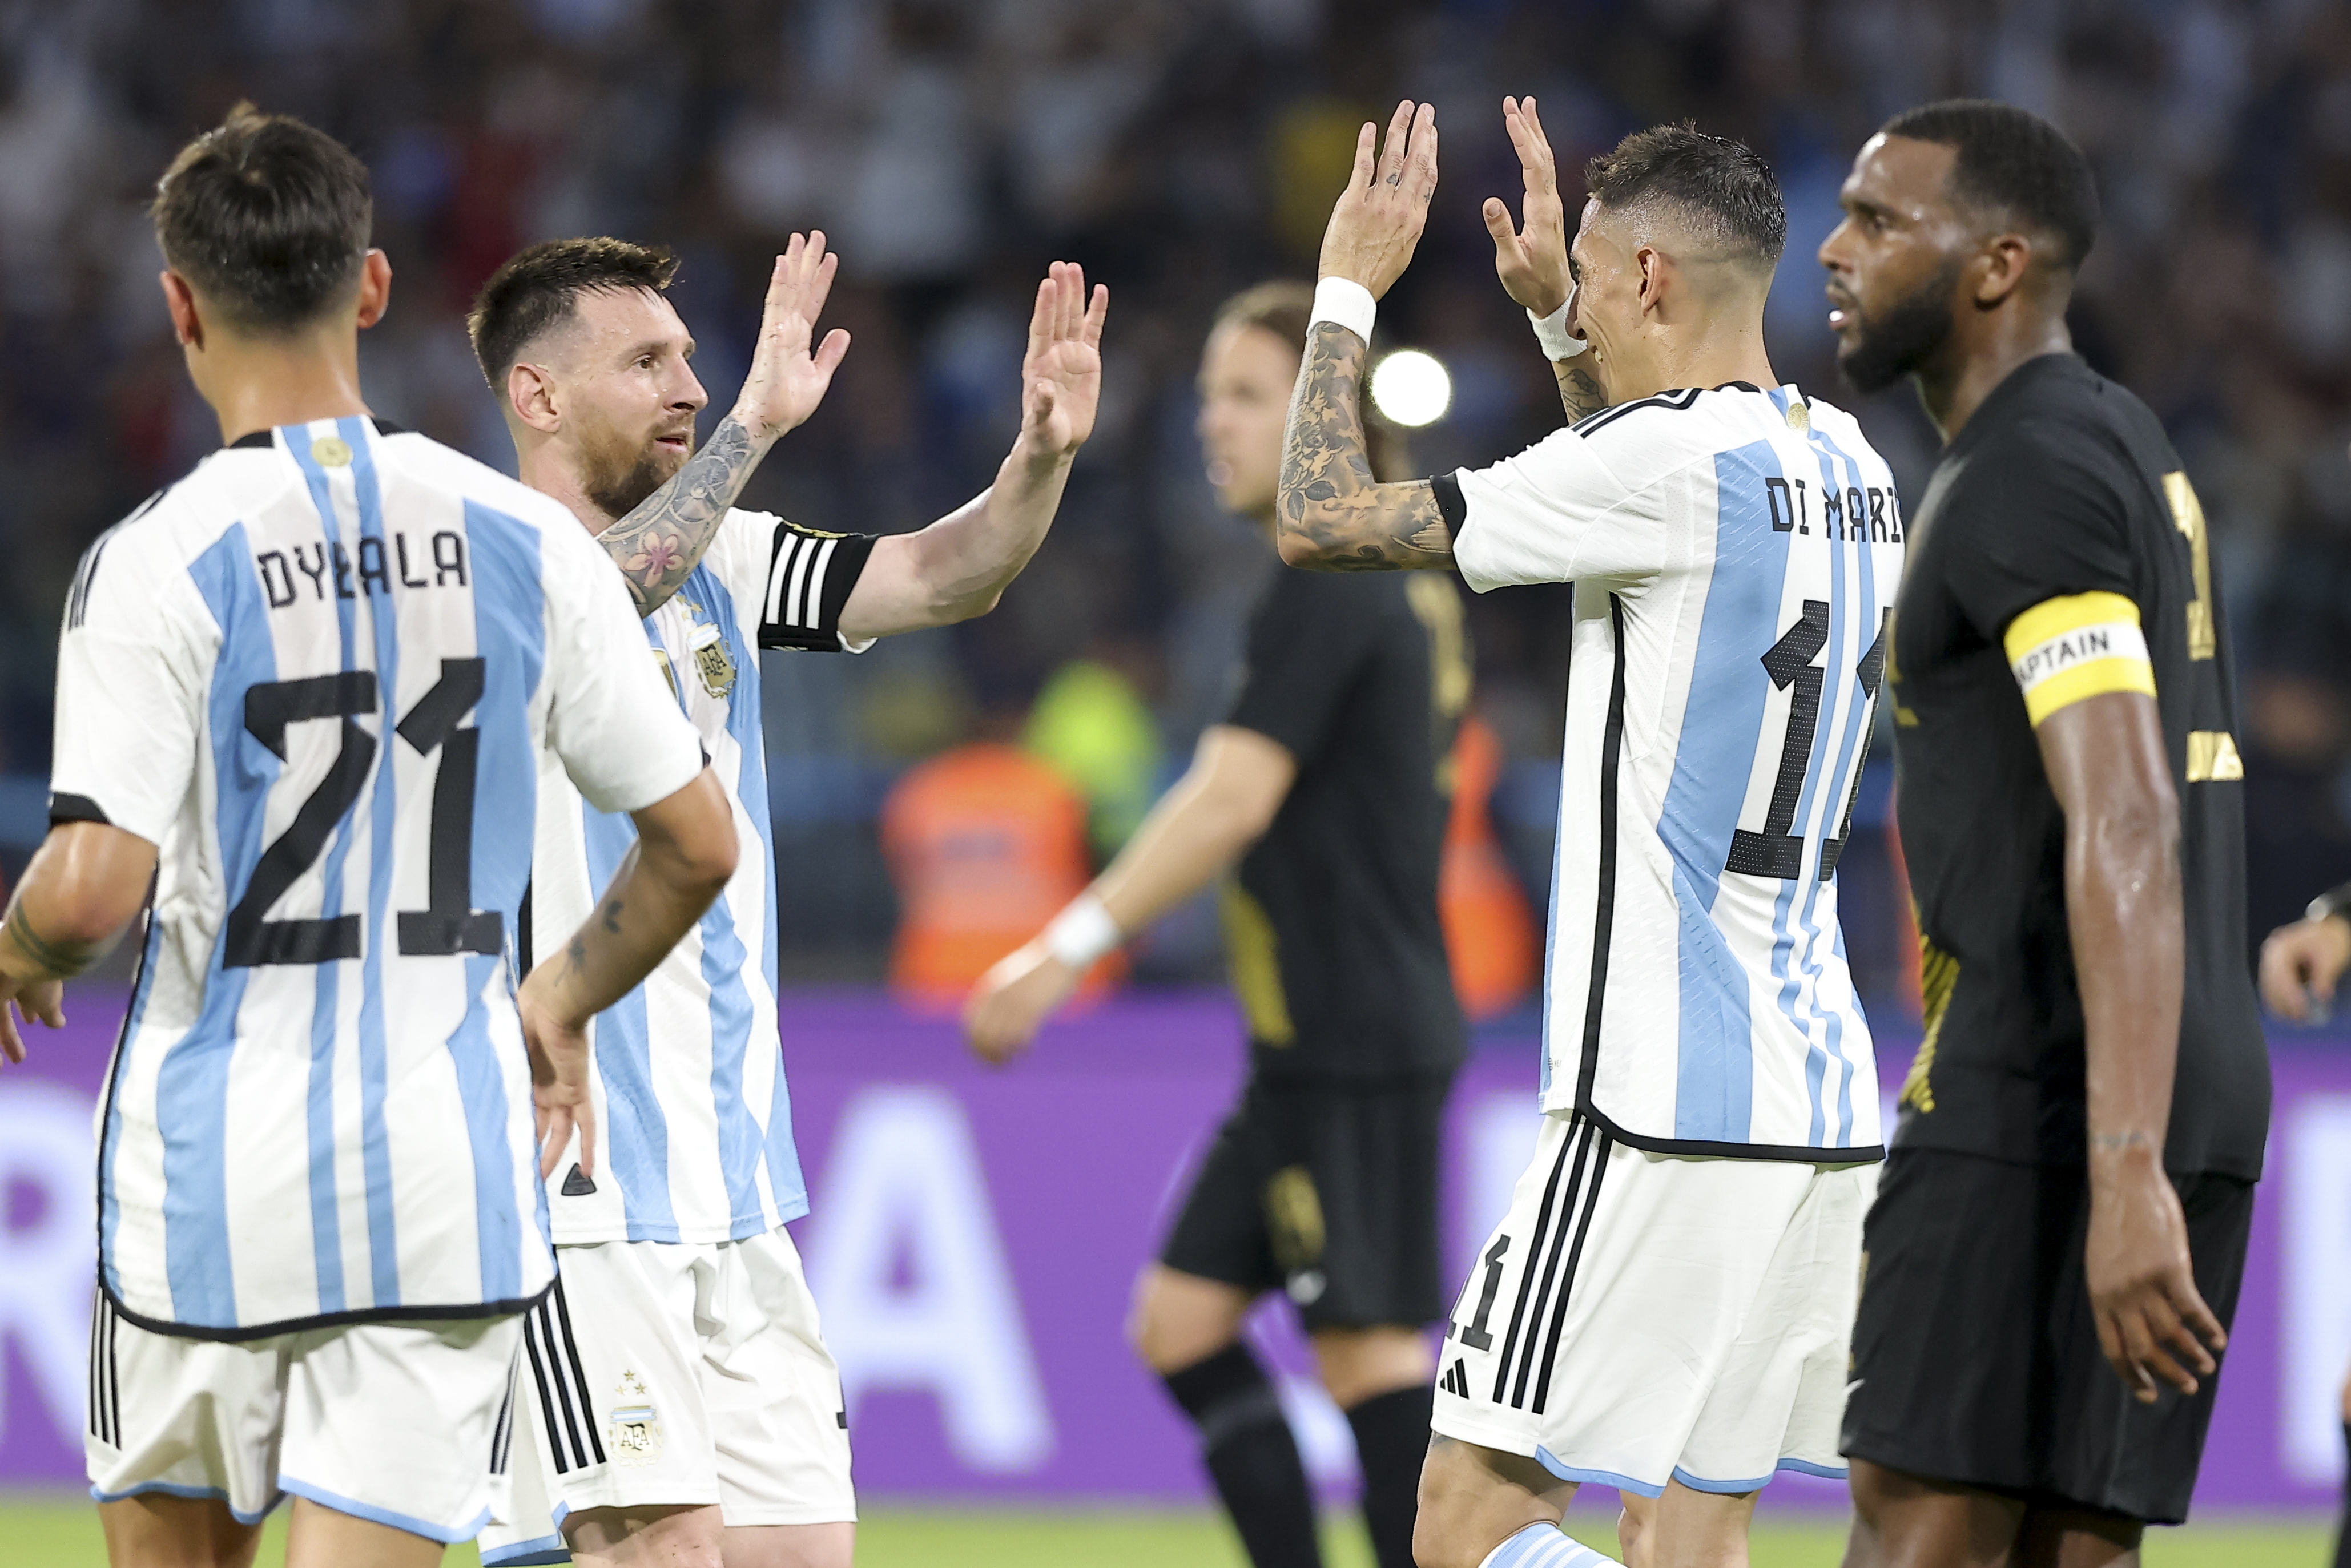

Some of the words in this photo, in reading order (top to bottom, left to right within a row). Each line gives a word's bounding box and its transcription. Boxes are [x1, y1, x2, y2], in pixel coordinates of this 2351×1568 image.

[1765, 477, 1809, 535] DI
[223, 658, 504, 970] 21
[621, 1422, 650, 1452] AFA
